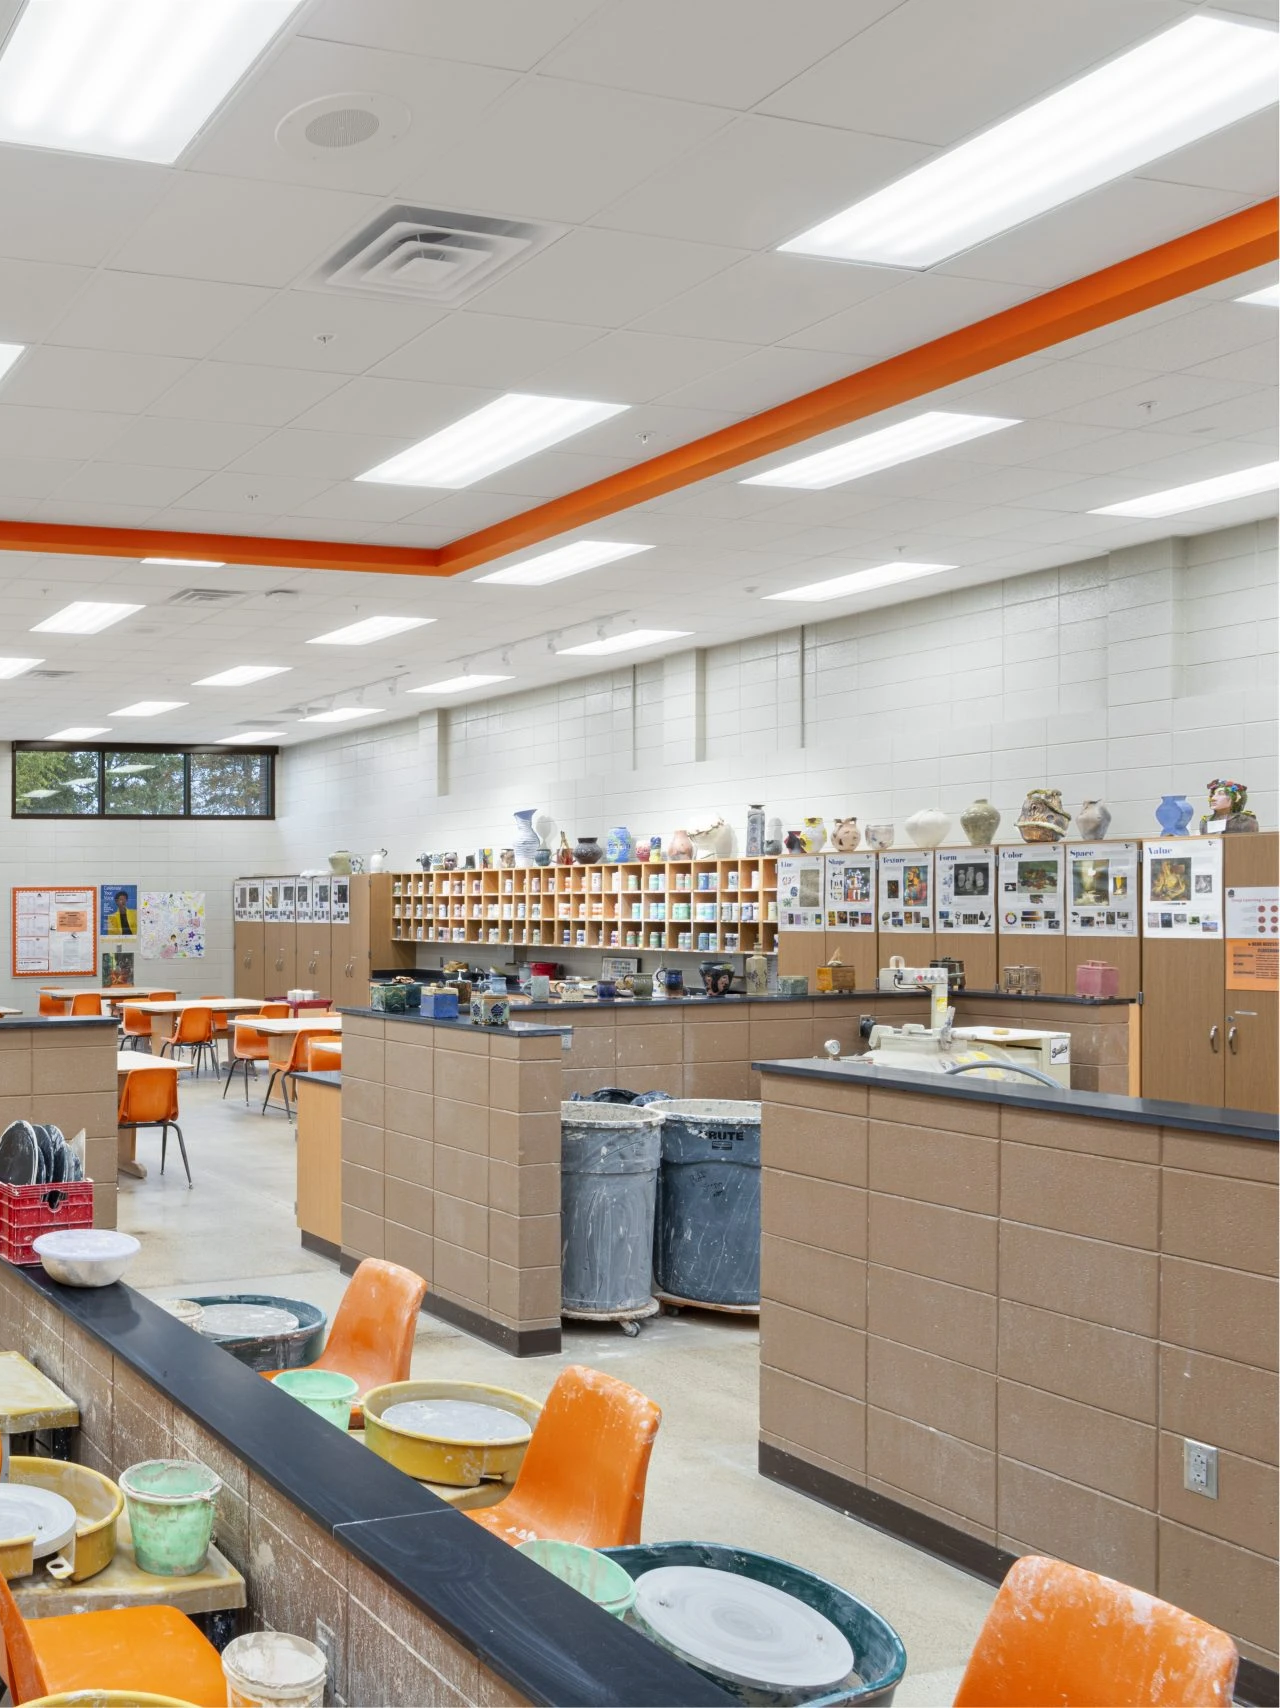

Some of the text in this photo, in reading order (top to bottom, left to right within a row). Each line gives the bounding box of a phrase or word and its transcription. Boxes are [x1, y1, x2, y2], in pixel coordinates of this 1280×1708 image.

[1002, 851, 1023, 859] Color
[1069, 849, 1094, 858] Space
[1148, 847, 1173, 855] Value
